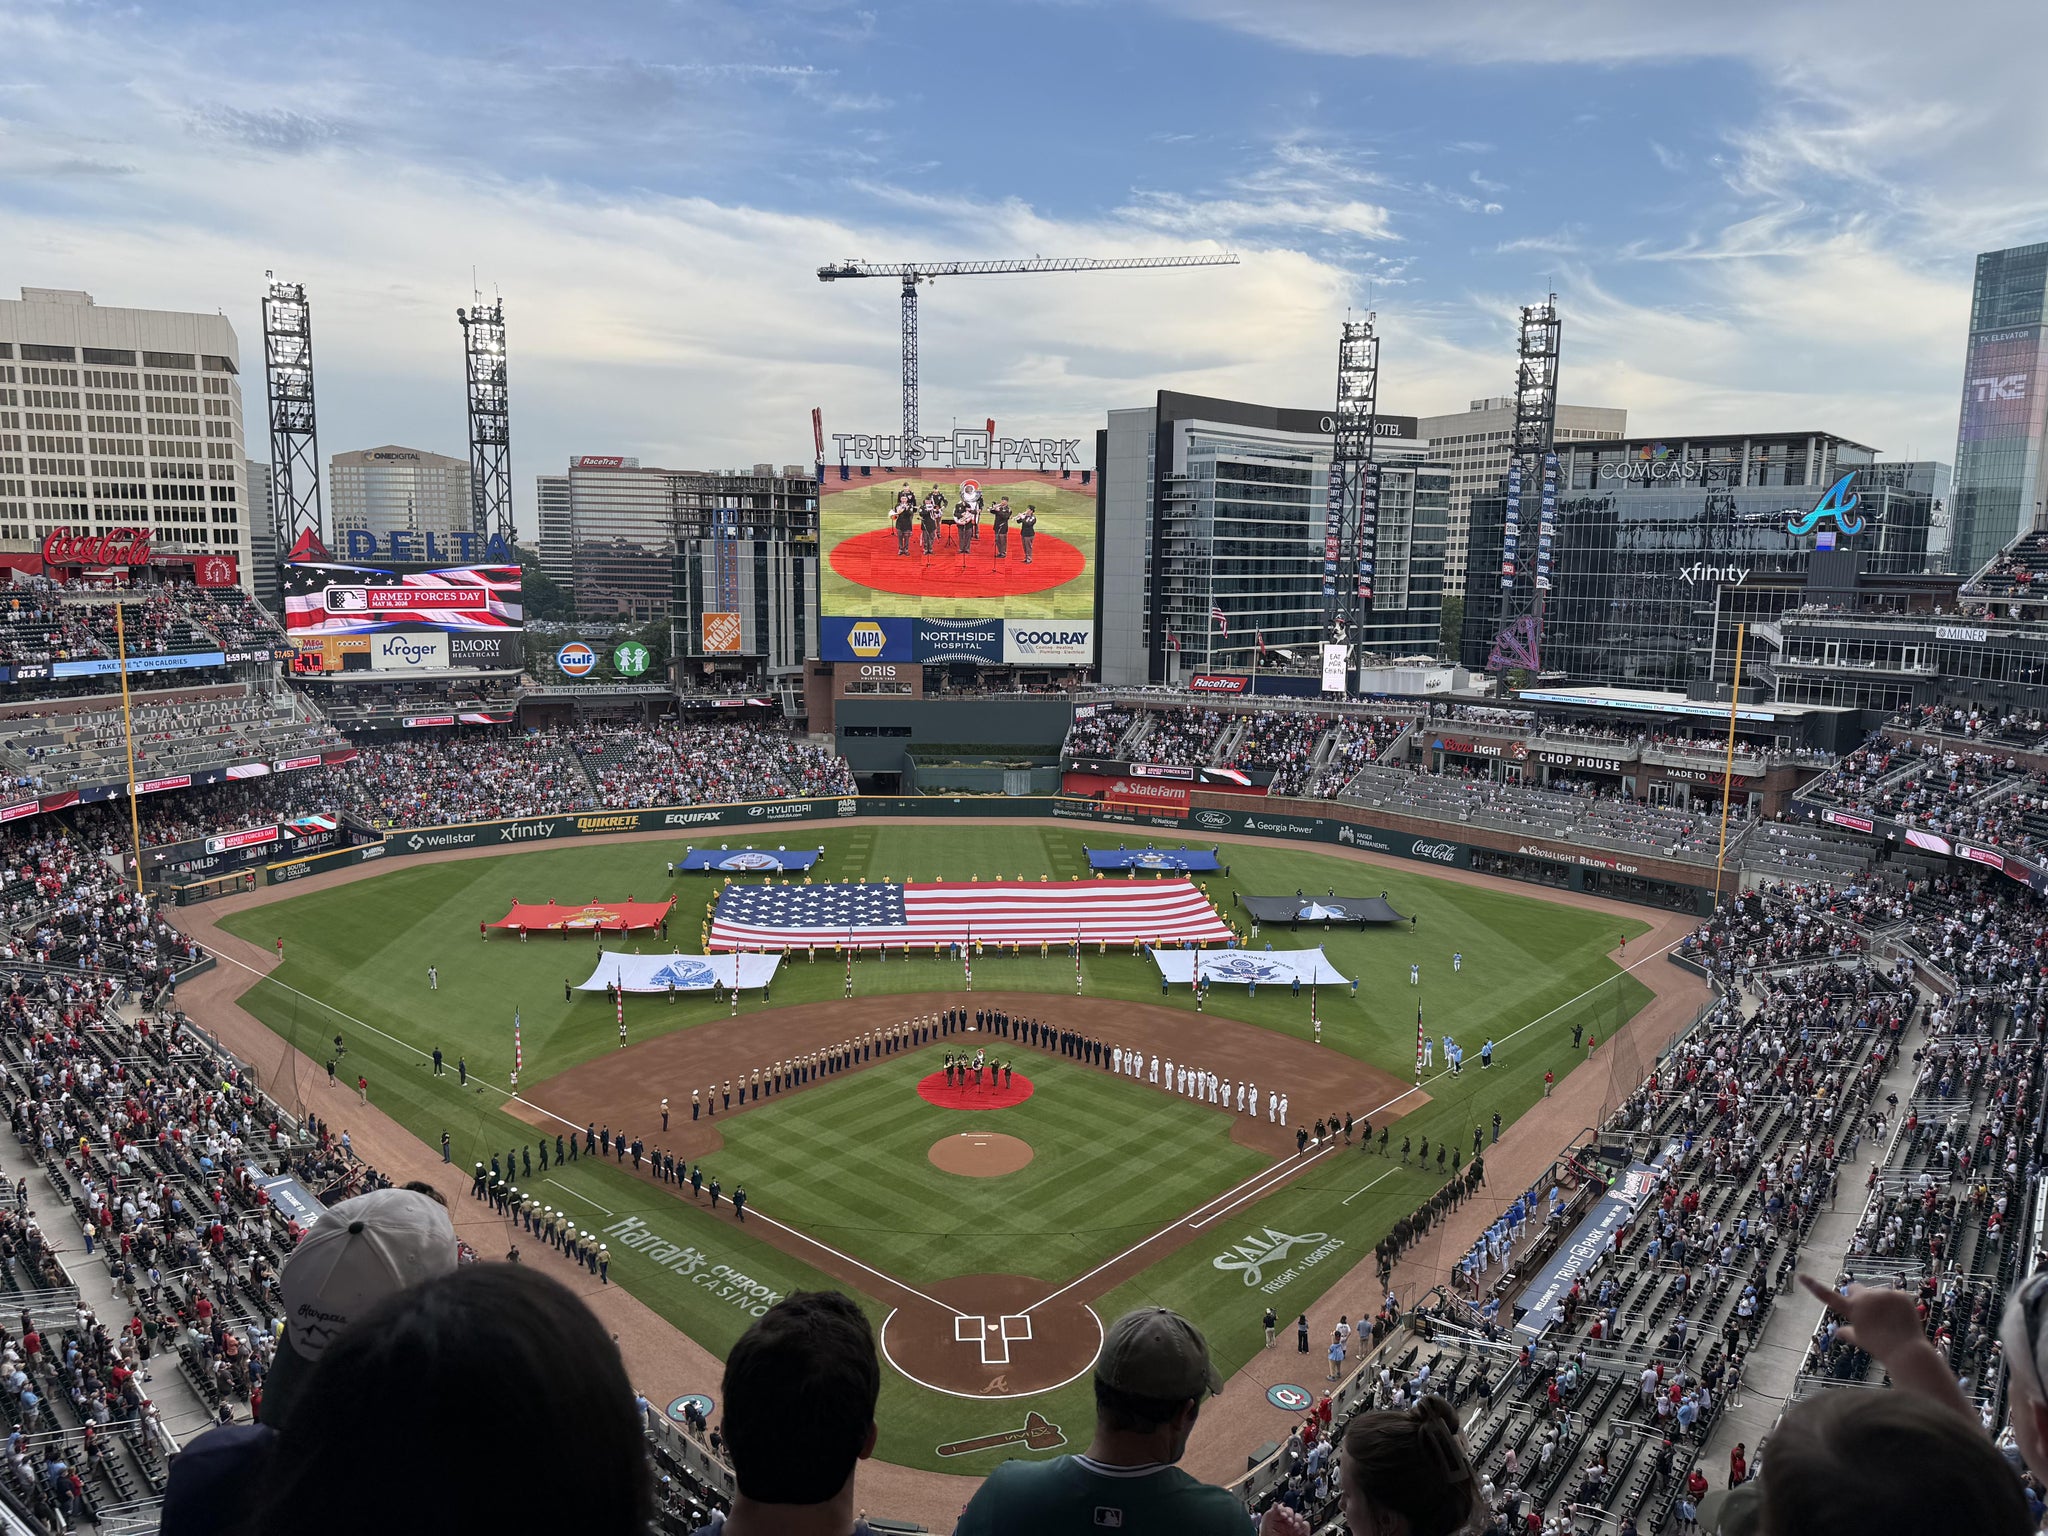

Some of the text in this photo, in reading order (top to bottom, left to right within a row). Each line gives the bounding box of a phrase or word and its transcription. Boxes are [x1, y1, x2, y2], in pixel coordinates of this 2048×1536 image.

[1992, 330, 2029, 341] ELEVATOR
[1972, 374, 2027, 402] TKE
[832, 434, 1080, 463] TRUIST PARK
[583, 458, 618, 466] RaceTrac
[1600, 460, 1707, 479] COMCAST
[44, 526, 154, 566] Coca-Cola
[347, 530, 512, 561] DELTA
[1679, 562, 1750, 586] xfinity
[372, 592, 480, 600] ARMED FORCES DAY
[706, 617, 722, 631] THE
[704, 614, 740, 650] HOME
[921, 632, 995, 642] NORTHSIDE
[1016, 632, 1089, 644] COOLRAY
[1947, 628, 1985, 640] MILNER
[718, 627, 740, 650] DEPOT
[854, 632, 880, 647] NAPA
[383, 636, 436, 664] Kroger
[452, 640, 501, 651] EMORY
[241, 653, 251, 661] PM
[274, 650, 294, 658] $7,453
[560, 654, 592, 666] Gulf
[860, 665, 896, 676] ORIS
[1194, 679, 1240, 688] RaceTrac
[1444, 738, 1501, 756] Coors LIGHT
[1539, 752, 1620, 771] CHOP HOUSE
[1667, 769, 1692, 779] MADE
[767, 804, 811, 814] HYUNDAI
[577, 816, 638, 828] QUIKRETE
[665, 812, 721, 825] EQUIFAX
[1202, 813, 1224, 824] Ford
[500, 822, 555, 841] xfinity
[1258, 822, 1312, 833] Georgia Power
[426, 834, 476, 846] Wellstar
[1357, 840, 1388, 850] PERMANENTE
[1412, 840, 1457, 861] Coca-Cola
[191, 858, 219, 870] MLB+
[1528, 846, 1552, 858] Coors
[1552, 853, 1576, 862] LIGHT
[1580, 856, 1606, 869] BELOW
[1616, 863, 1638, 873] CHOP
[287, 863, 305, 871] SOUTH
[287, 867, 310, 876] COLLEGE
[1600, 1216, 1614, 1228] HOME
[1213, 1228, 1328, 1286] SAIA
[1260, 1238, 1345, 1294] FREIGHT LOGISTICS
[1533, 1289, 1556, 1311] WELCOME
[1554, 1255, 1584, 1281] TRUIST
[1582, 1228, 1606, 1247] PARK
[710, 1264, 785, 1305] CHEROK
